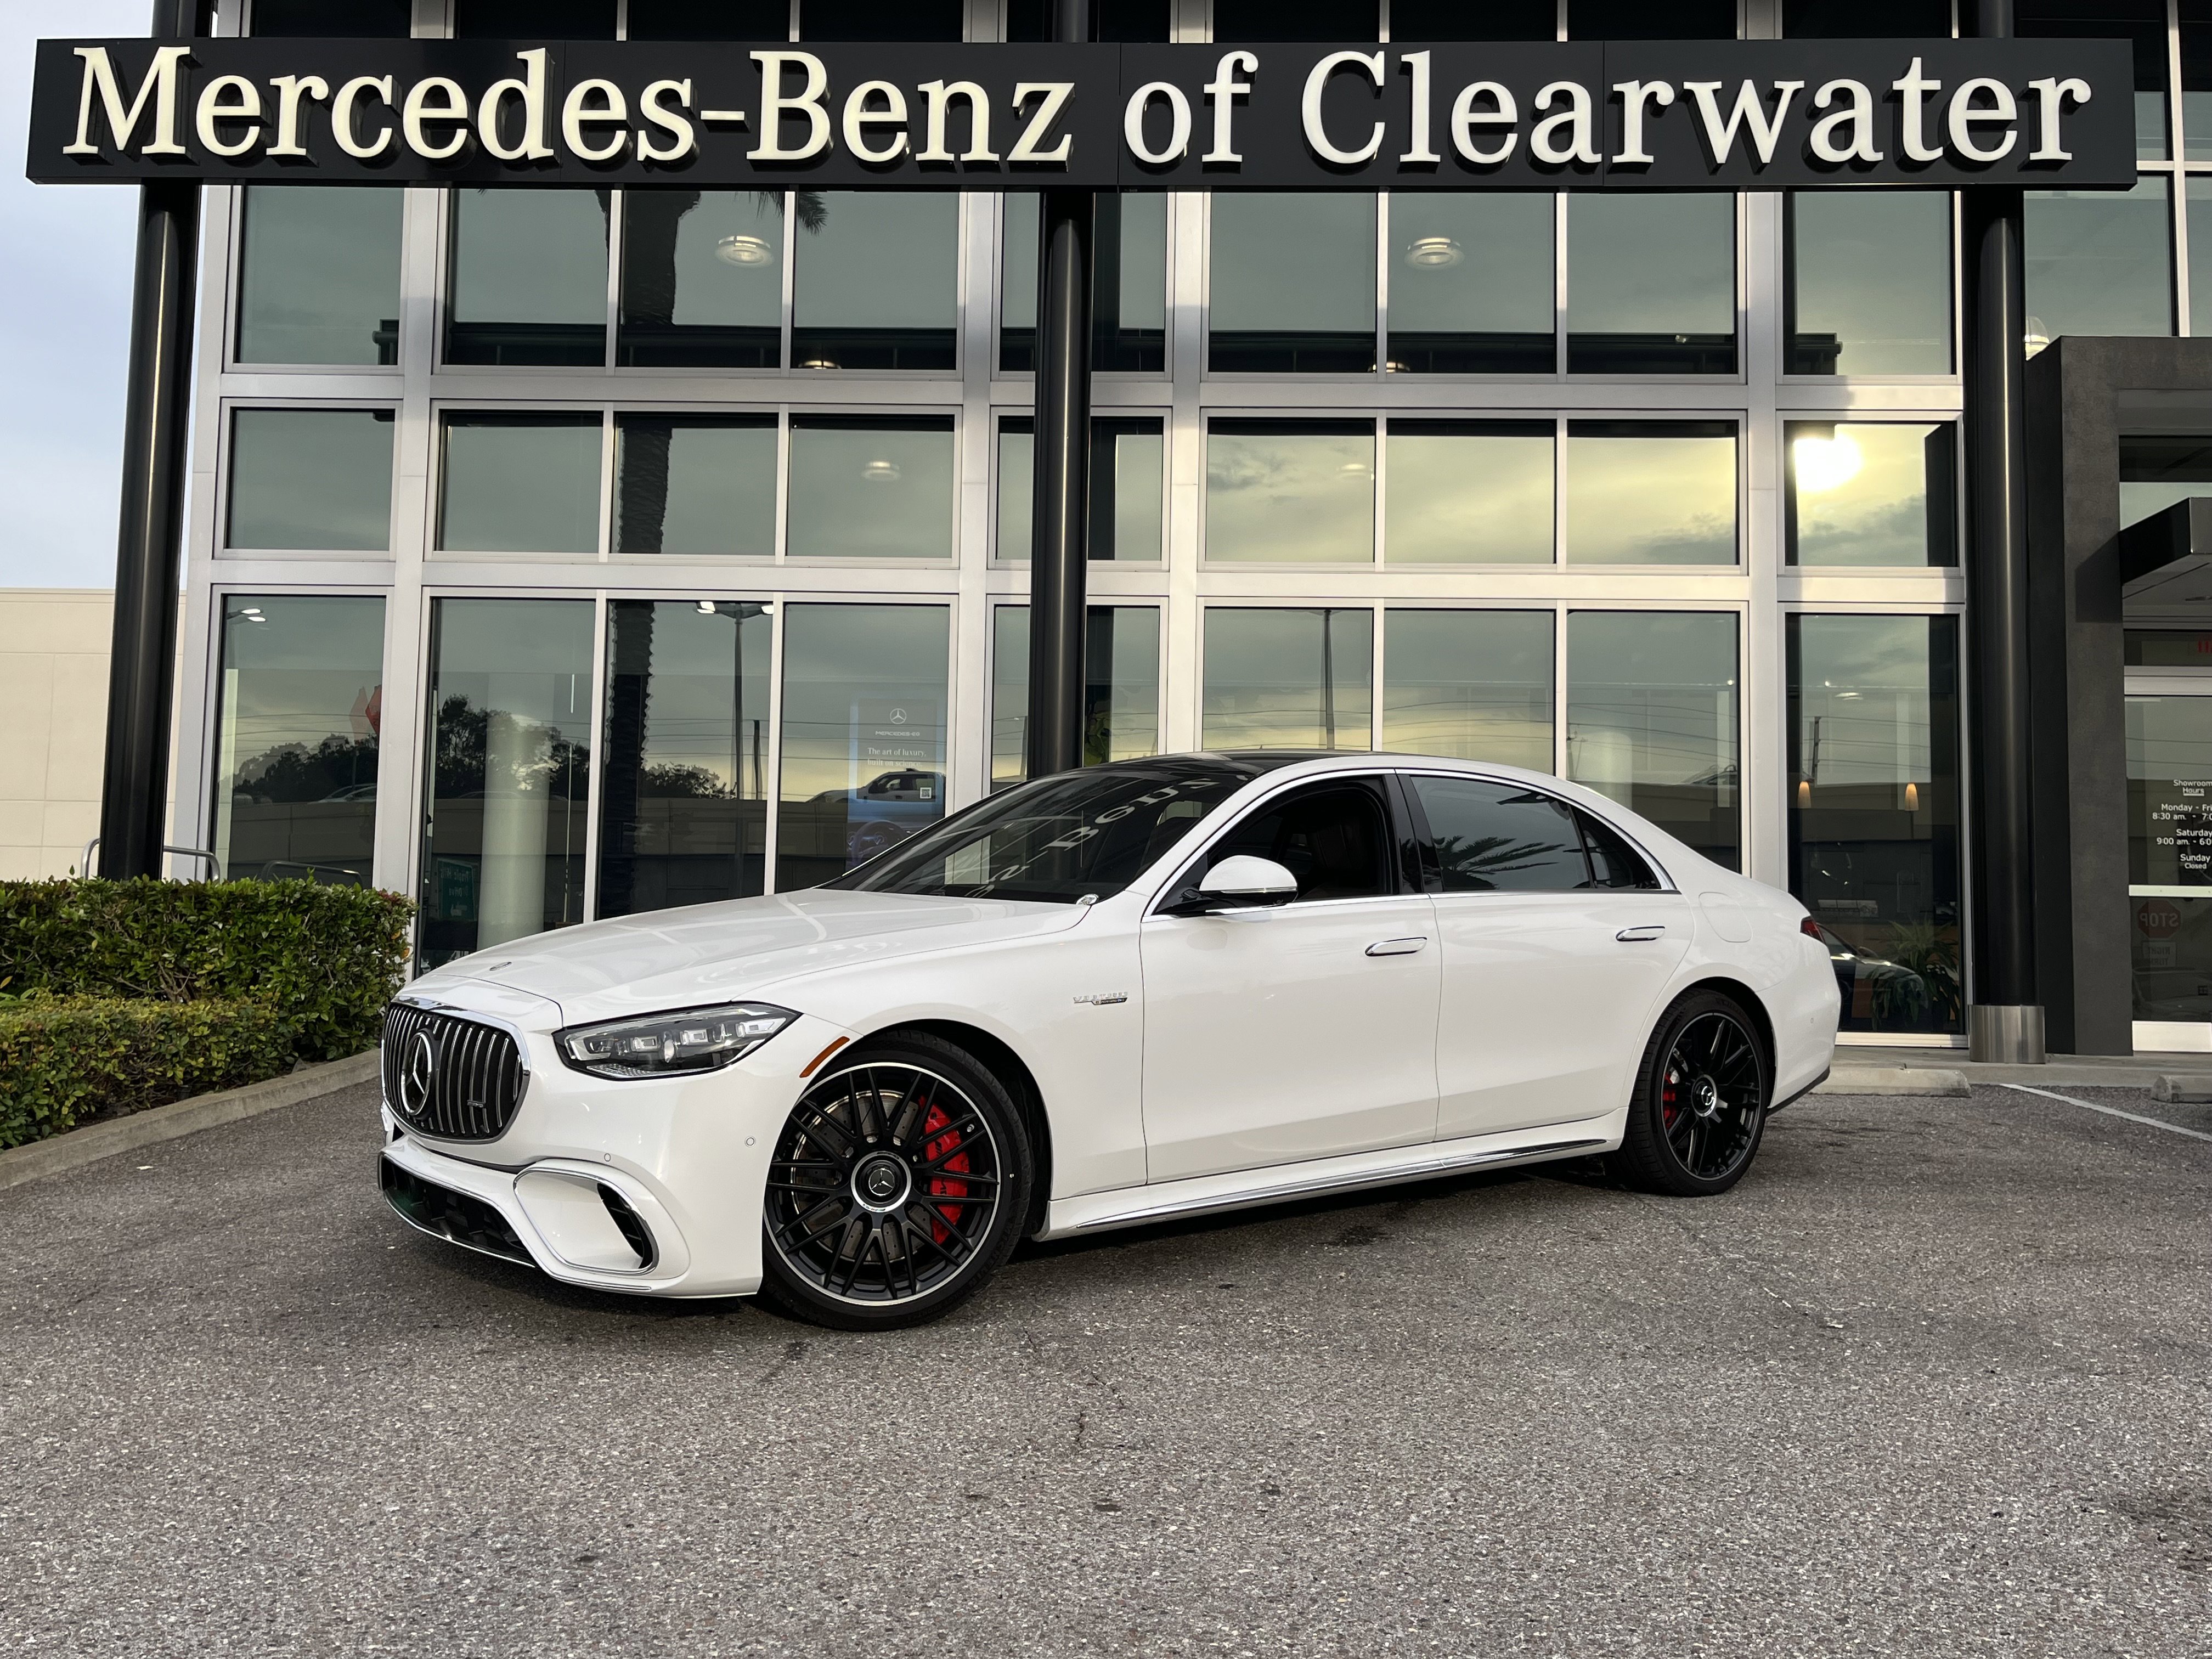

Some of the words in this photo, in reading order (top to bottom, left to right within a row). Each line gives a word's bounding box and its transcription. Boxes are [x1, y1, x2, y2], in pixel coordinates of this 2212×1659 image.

[63, 46, 1076, 164] Mercedes-Benz
[1124, 50, 1259, 163] of
[1301, 49, 2091, 163] Clearwater
[902, 749, 926, 758] luxury,
[2161, 804, 2193, 812] Monday
[2176, 828, 2212, 838] Saturday
[2180, 854, 2211, 863] Sunday
